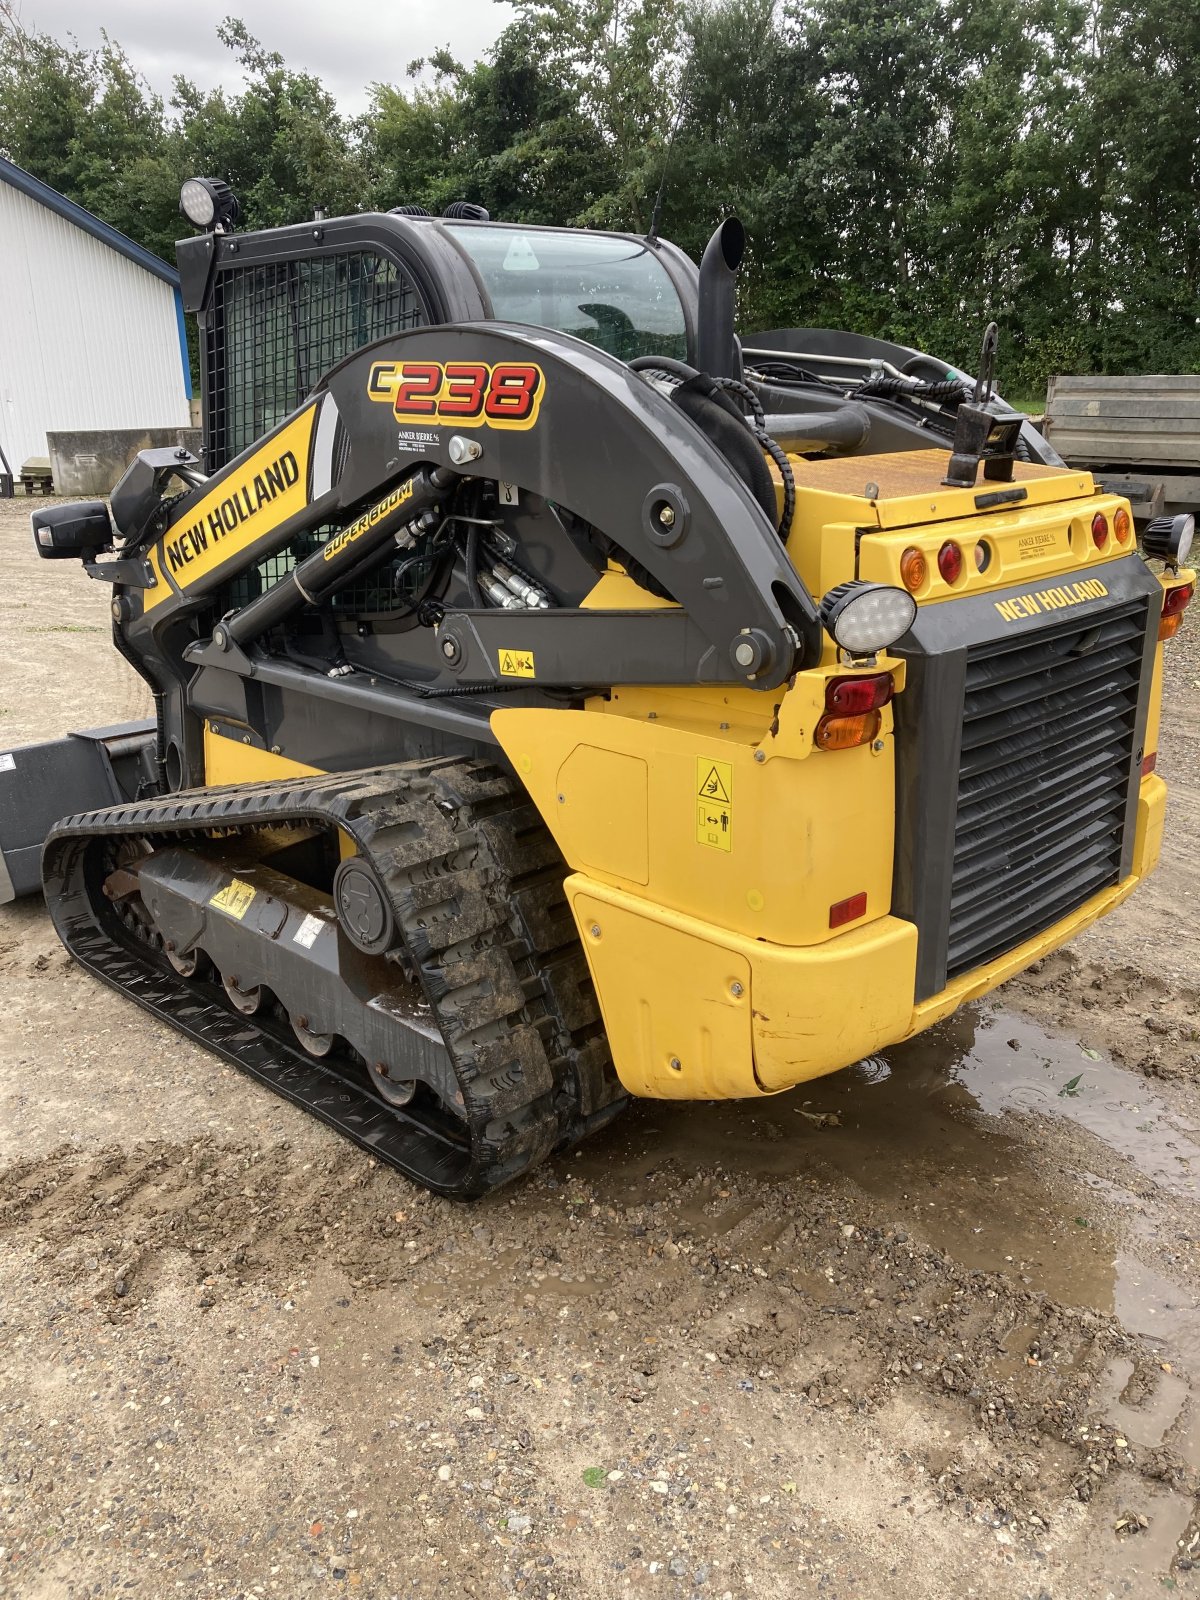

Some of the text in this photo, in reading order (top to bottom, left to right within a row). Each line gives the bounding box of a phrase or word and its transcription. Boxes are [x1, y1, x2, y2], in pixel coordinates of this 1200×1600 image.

[398, 431, 415, 440] ANKER
[166, 450, 299, 573] NEW HOLLAND
[324, 479, 413, 561] SUPER BOOM
[1018, 537, 1034, 548] ANKER
[994, 579, 1109, 622] NEW HOLLAND
